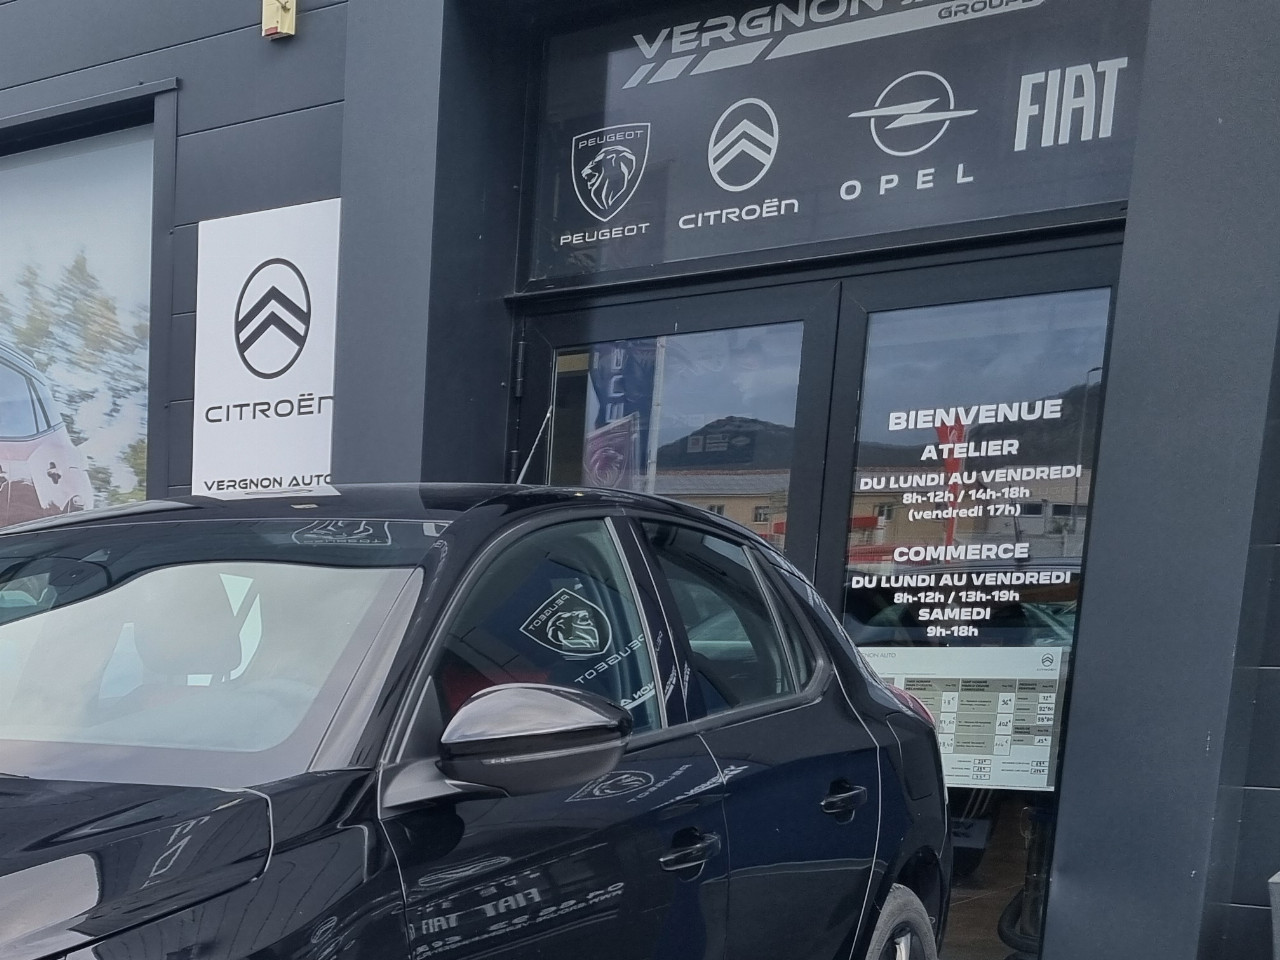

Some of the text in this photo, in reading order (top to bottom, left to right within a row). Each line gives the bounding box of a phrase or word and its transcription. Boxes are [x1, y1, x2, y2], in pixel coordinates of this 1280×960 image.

[937, 0, 1035, 20] GROU
[1014, 57, 1128, 151] FIAT
[578, 130, 644, 149] PEUGEOT
[839, 163, 974, 201] OPEL
[560, 223, 651, 246] PEUGEOT
[888, 398, 1063, 431] BIENVENUE
[921, 439, 1020, 461] ATELIER
[204, 473, 332, 492] VERGNON AUTO
[859, 464, 1082, 490] DU LUNDI AU VENDREDI
[902, 488, 954, 504] 8h-12h
[968, 486, 1030, 501] 14h-18h
[908, 503, 1021, 521] (vendredi 17h)
[893, 543, 1030, 562] COMMERCE
[851, 571, 1071, 588] DU LUNDI AU VENDREDI
[893, 591, 945, 604] 8h-12h
[958, 590, 1019, 603] 13h-19h
[918, 607, 991, 621] SAMEDI
[926, 625, 979, 637] 9h-18h
